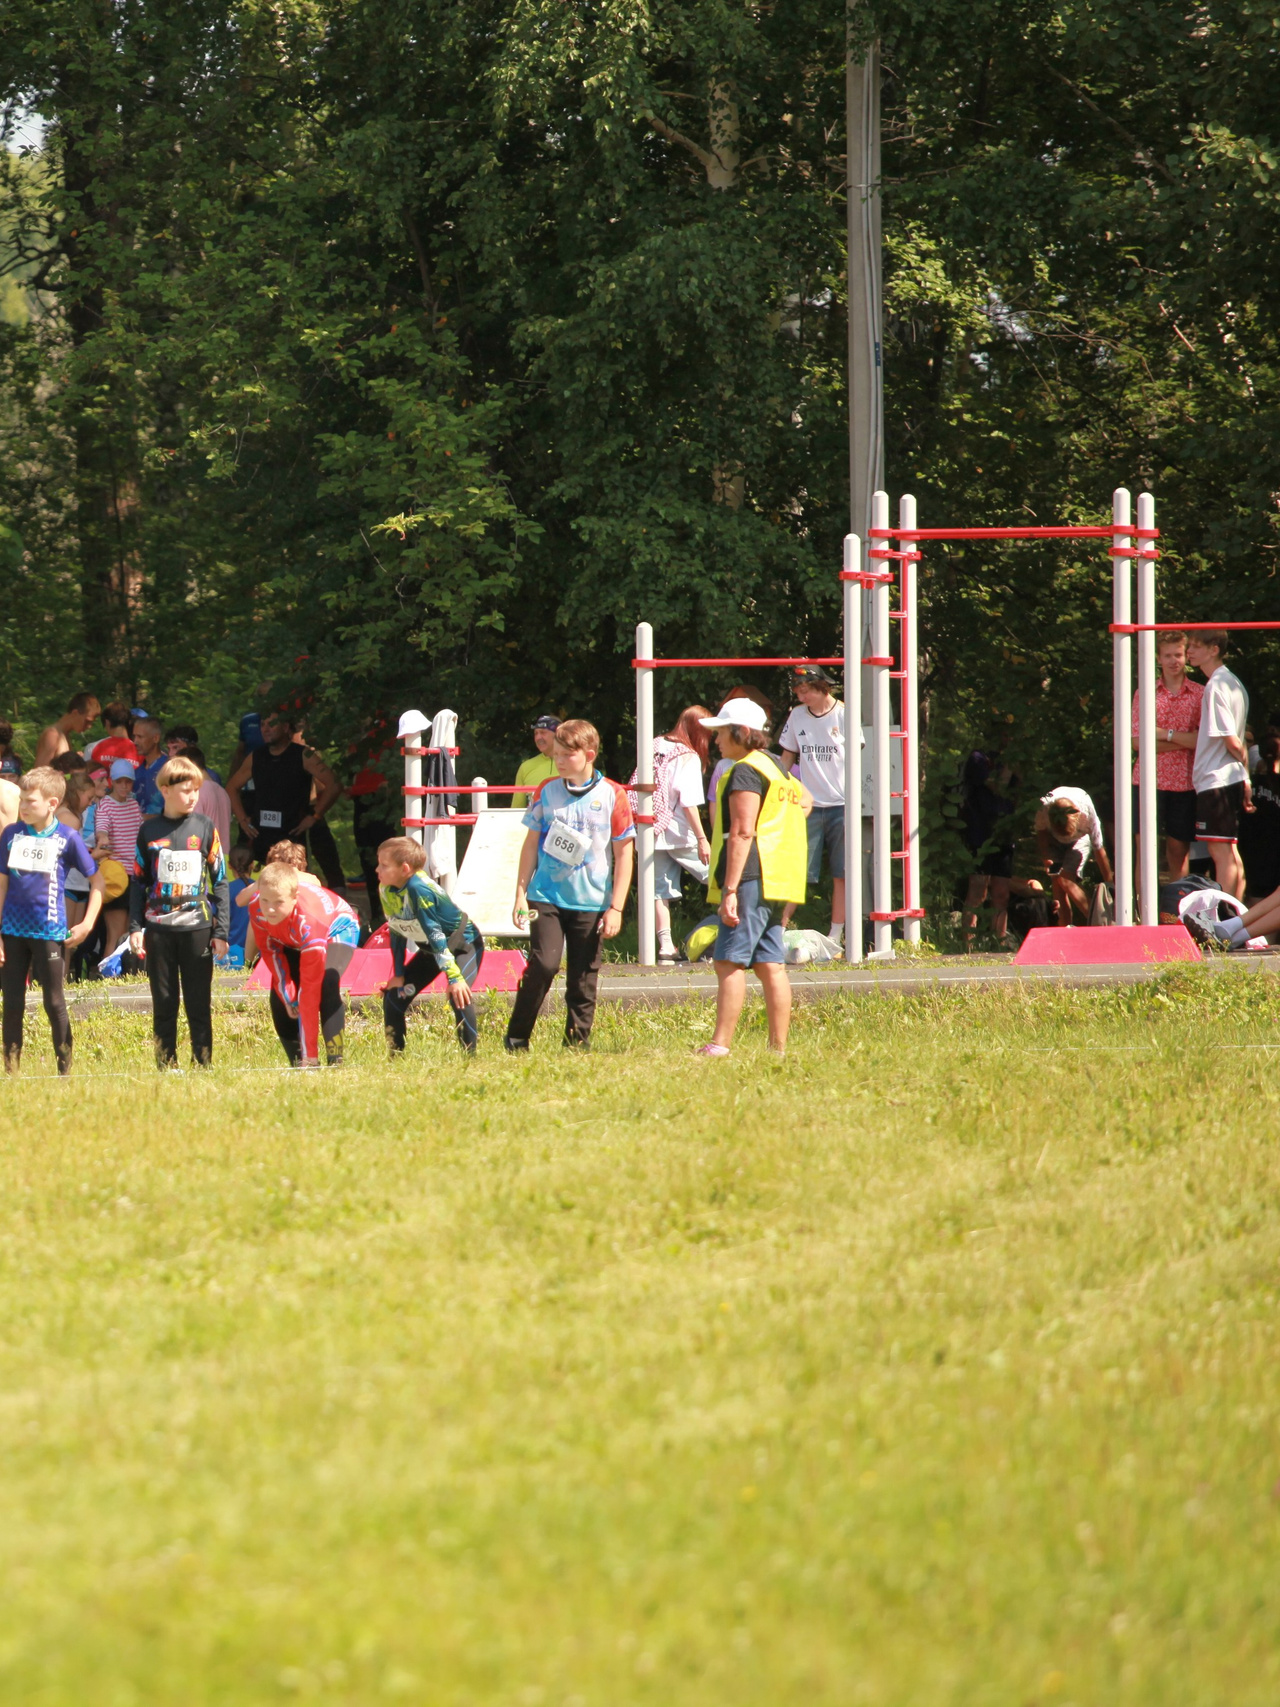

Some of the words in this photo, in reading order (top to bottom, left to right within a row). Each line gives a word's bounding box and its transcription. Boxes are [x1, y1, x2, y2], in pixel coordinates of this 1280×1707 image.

[801, 744, 838, 753] Emirates
[263, 813, 276, 821] 828
[554, 836, 575, 853] 658
[22, 848, 43, 859] 656
